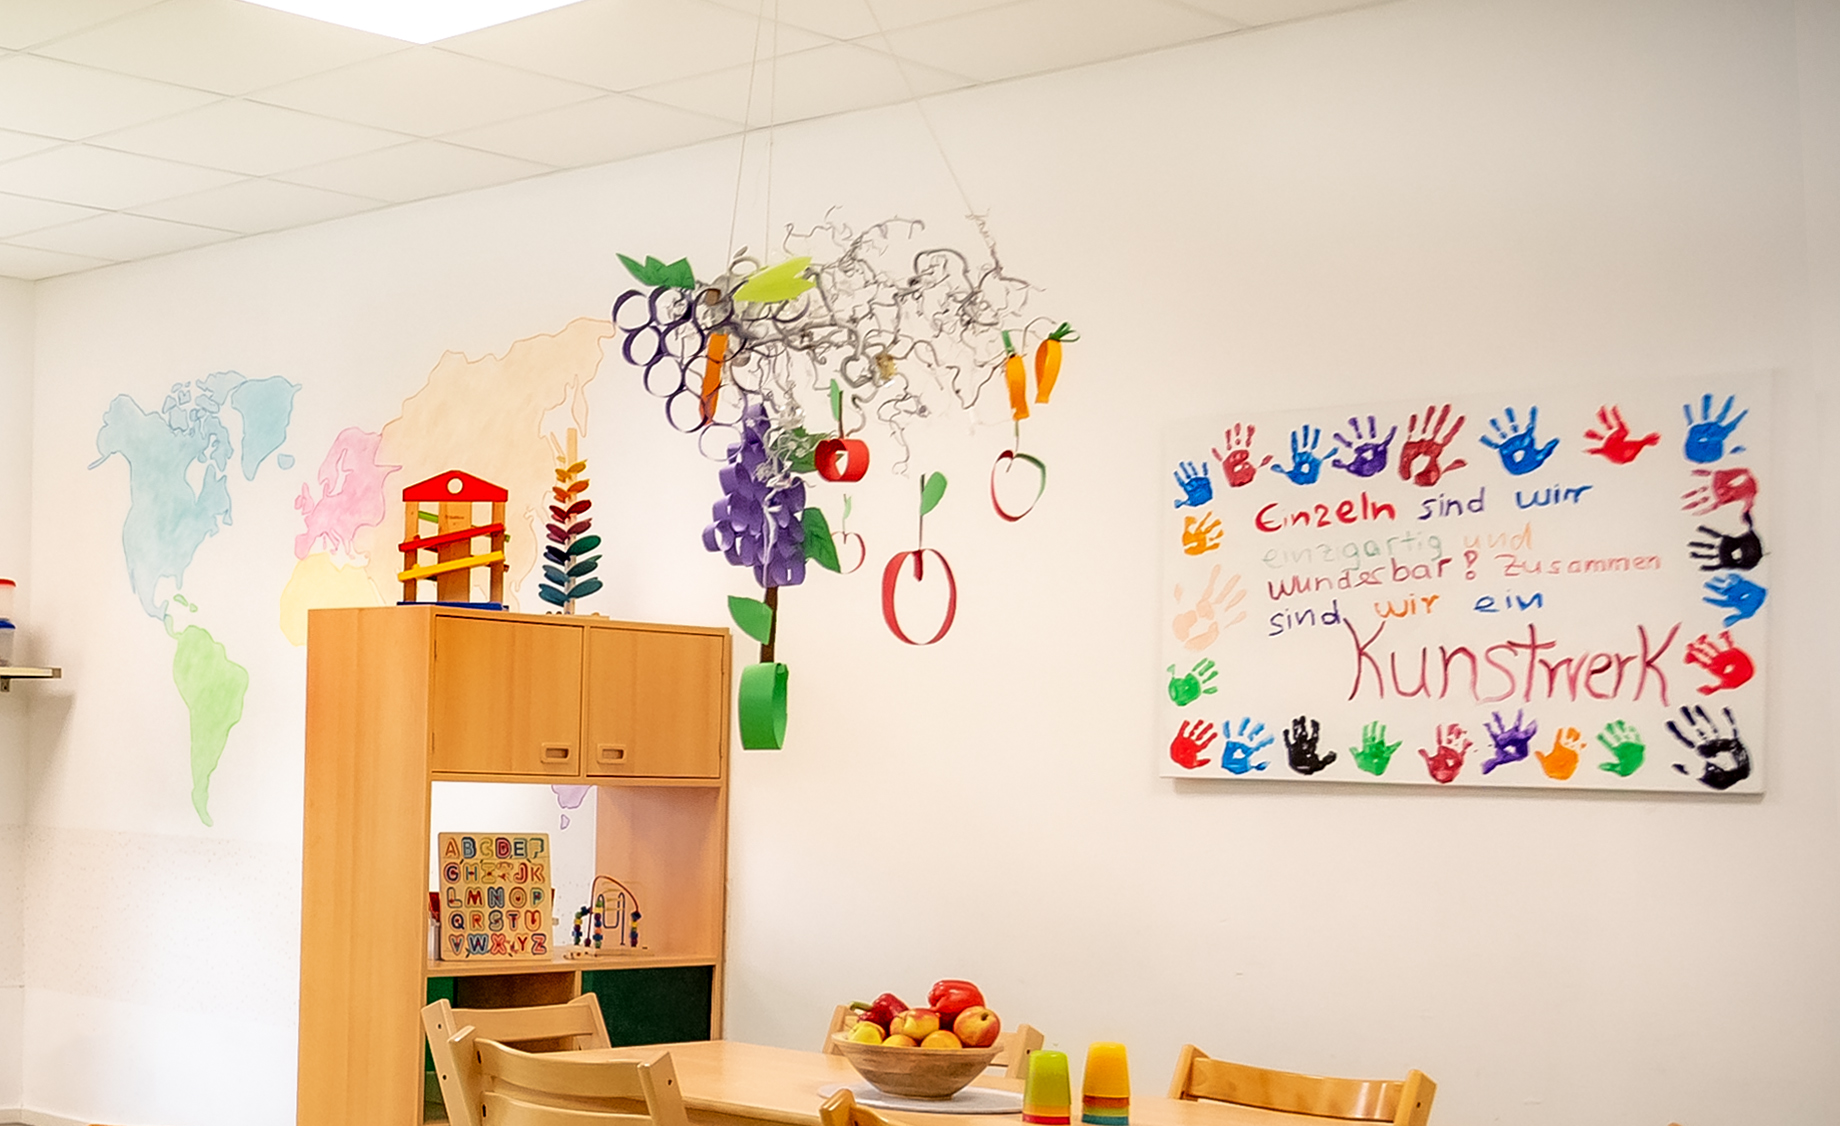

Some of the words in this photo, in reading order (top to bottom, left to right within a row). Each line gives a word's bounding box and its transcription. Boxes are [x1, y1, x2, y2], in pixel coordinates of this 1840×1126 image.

[1255, 491, 1397, 533] Einzeln
[1416, 486, 1486, 521] sind
[1463, 522, 1533, 551] und
[1268, 599, 1341, 637] sind
[1373, 593, 1441, 619] wir
[1473, 589, 1544, 613] ein
